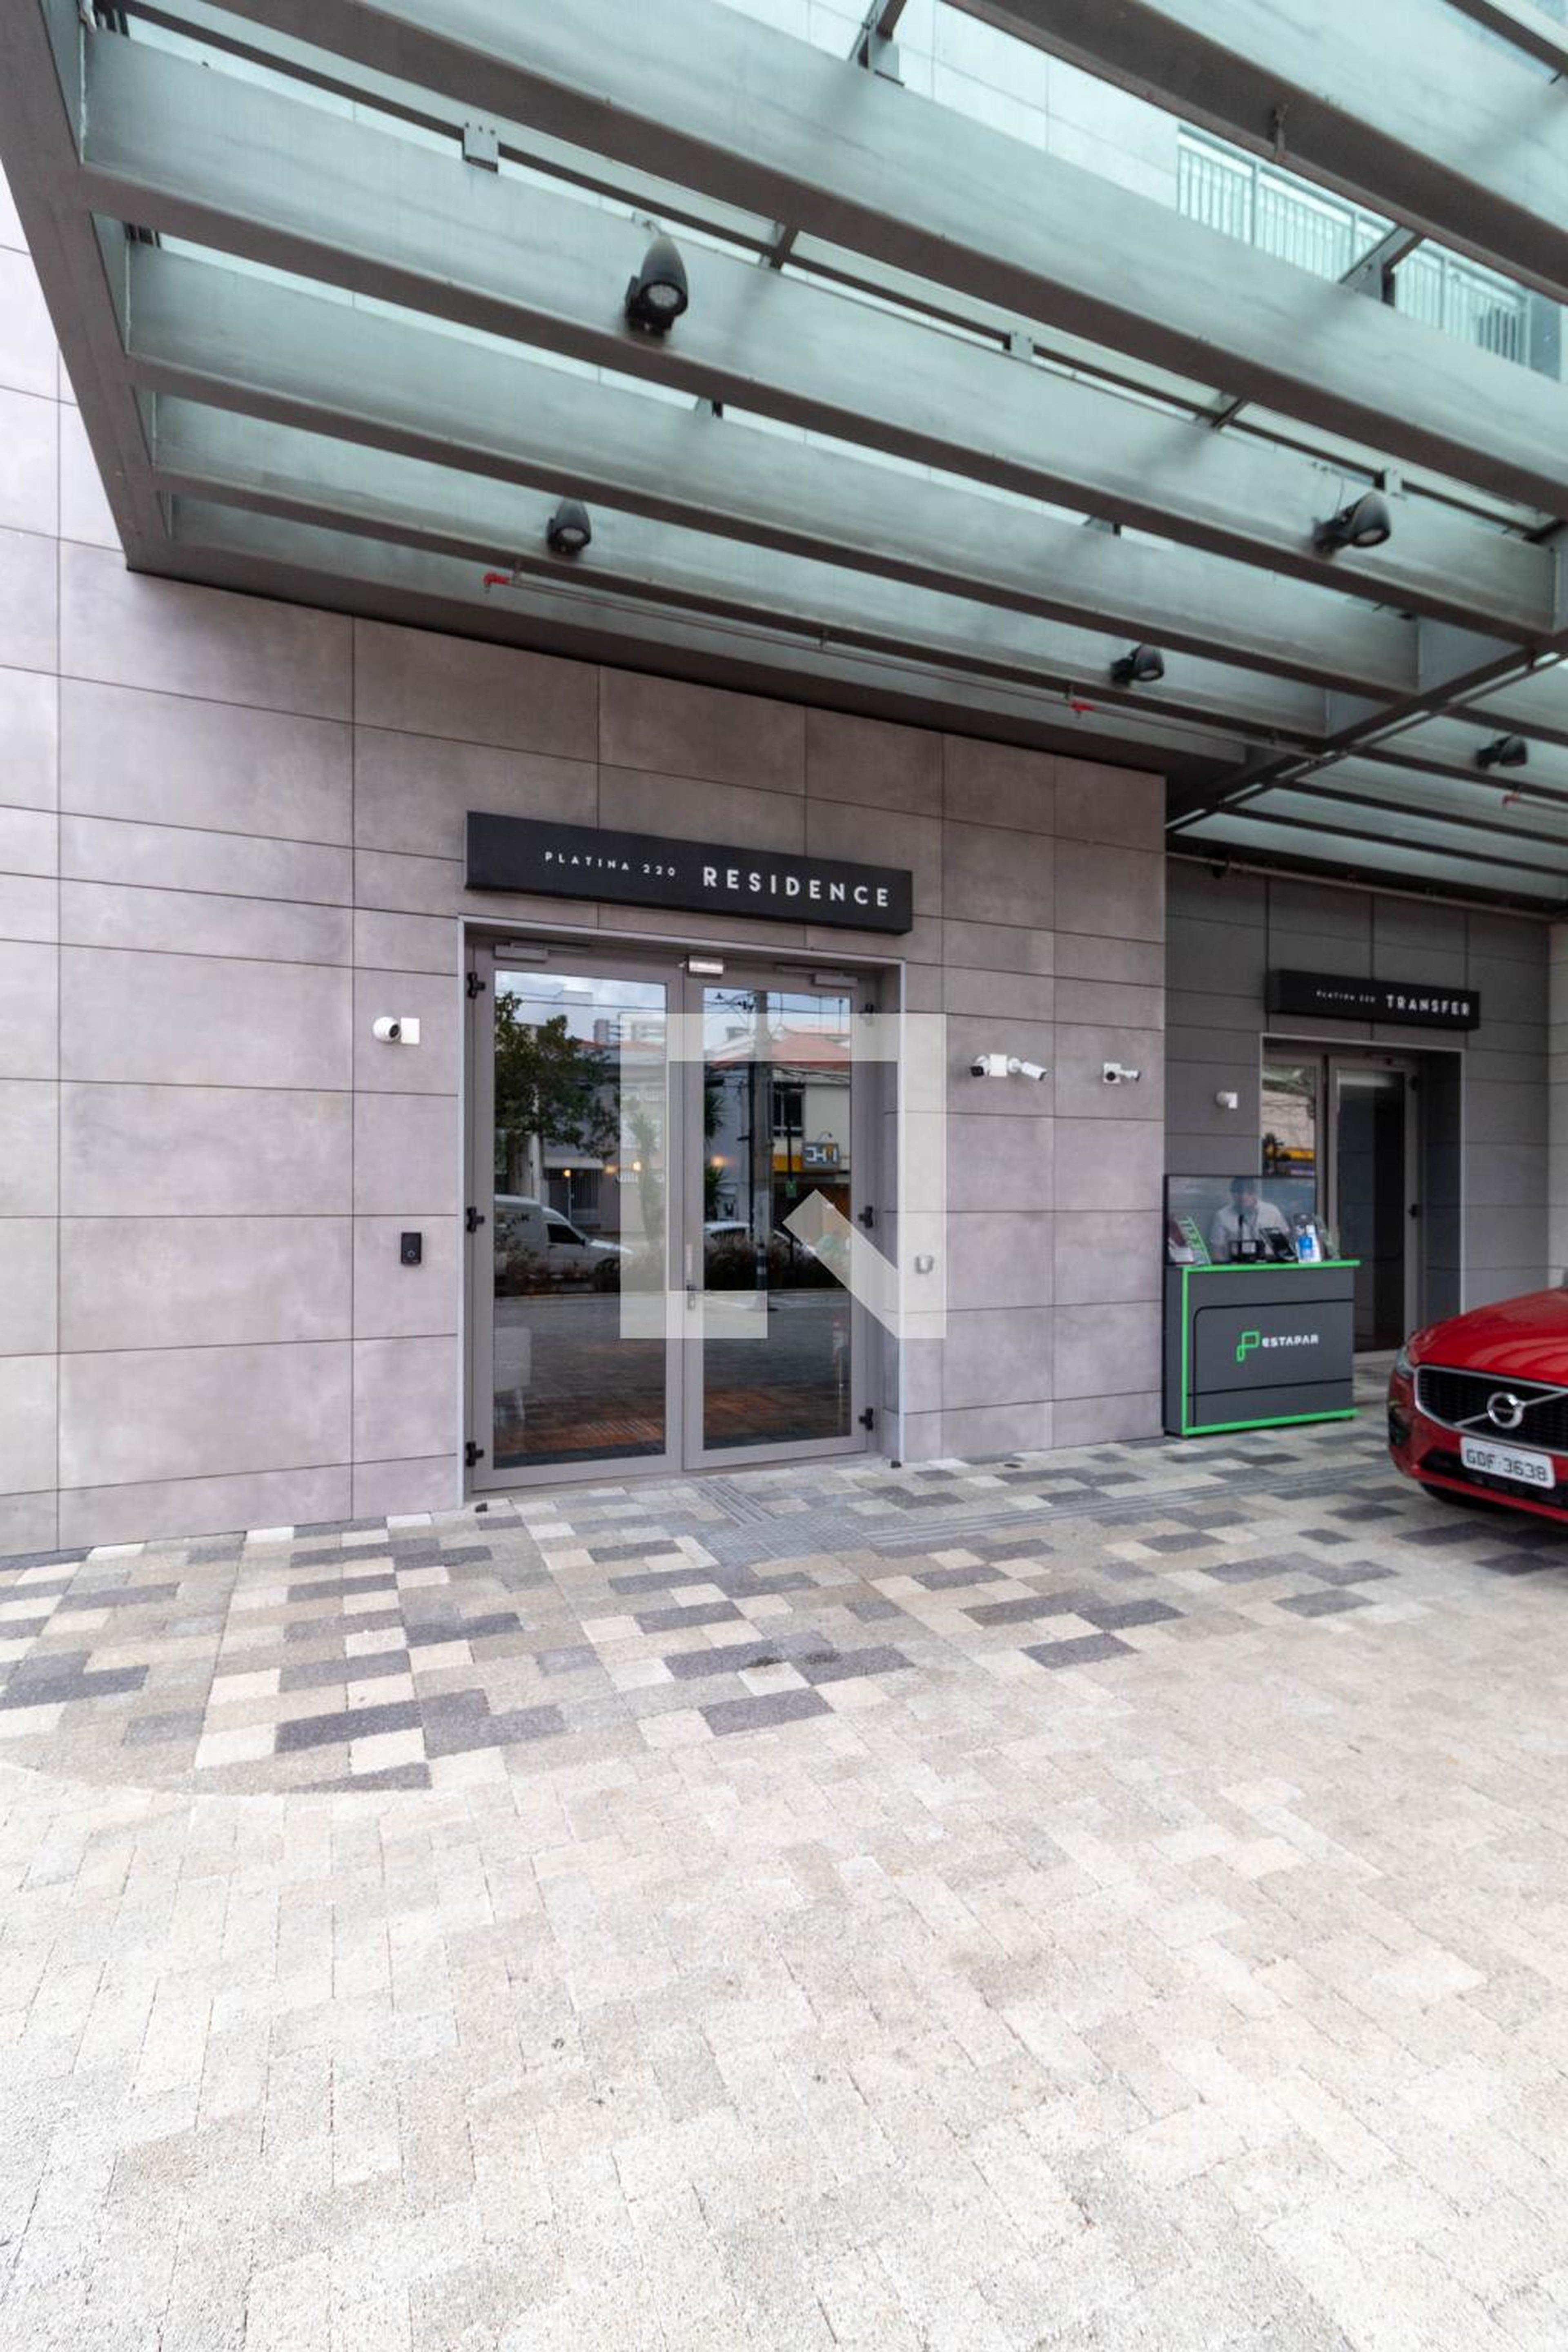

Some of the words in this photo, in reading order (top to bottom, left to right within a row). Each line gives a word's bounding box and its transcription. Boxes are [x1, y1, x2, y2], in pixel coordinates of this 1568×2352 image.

[545, 851, 630, 871] PLATINA
[643, 864, 676, 876] 220
[703, 866, 889, 907] RESIDENCE
[1386, 994, 1470, 1016] TRANSFER
[1262, 1334, 1319, 1348] ESTAPAR
